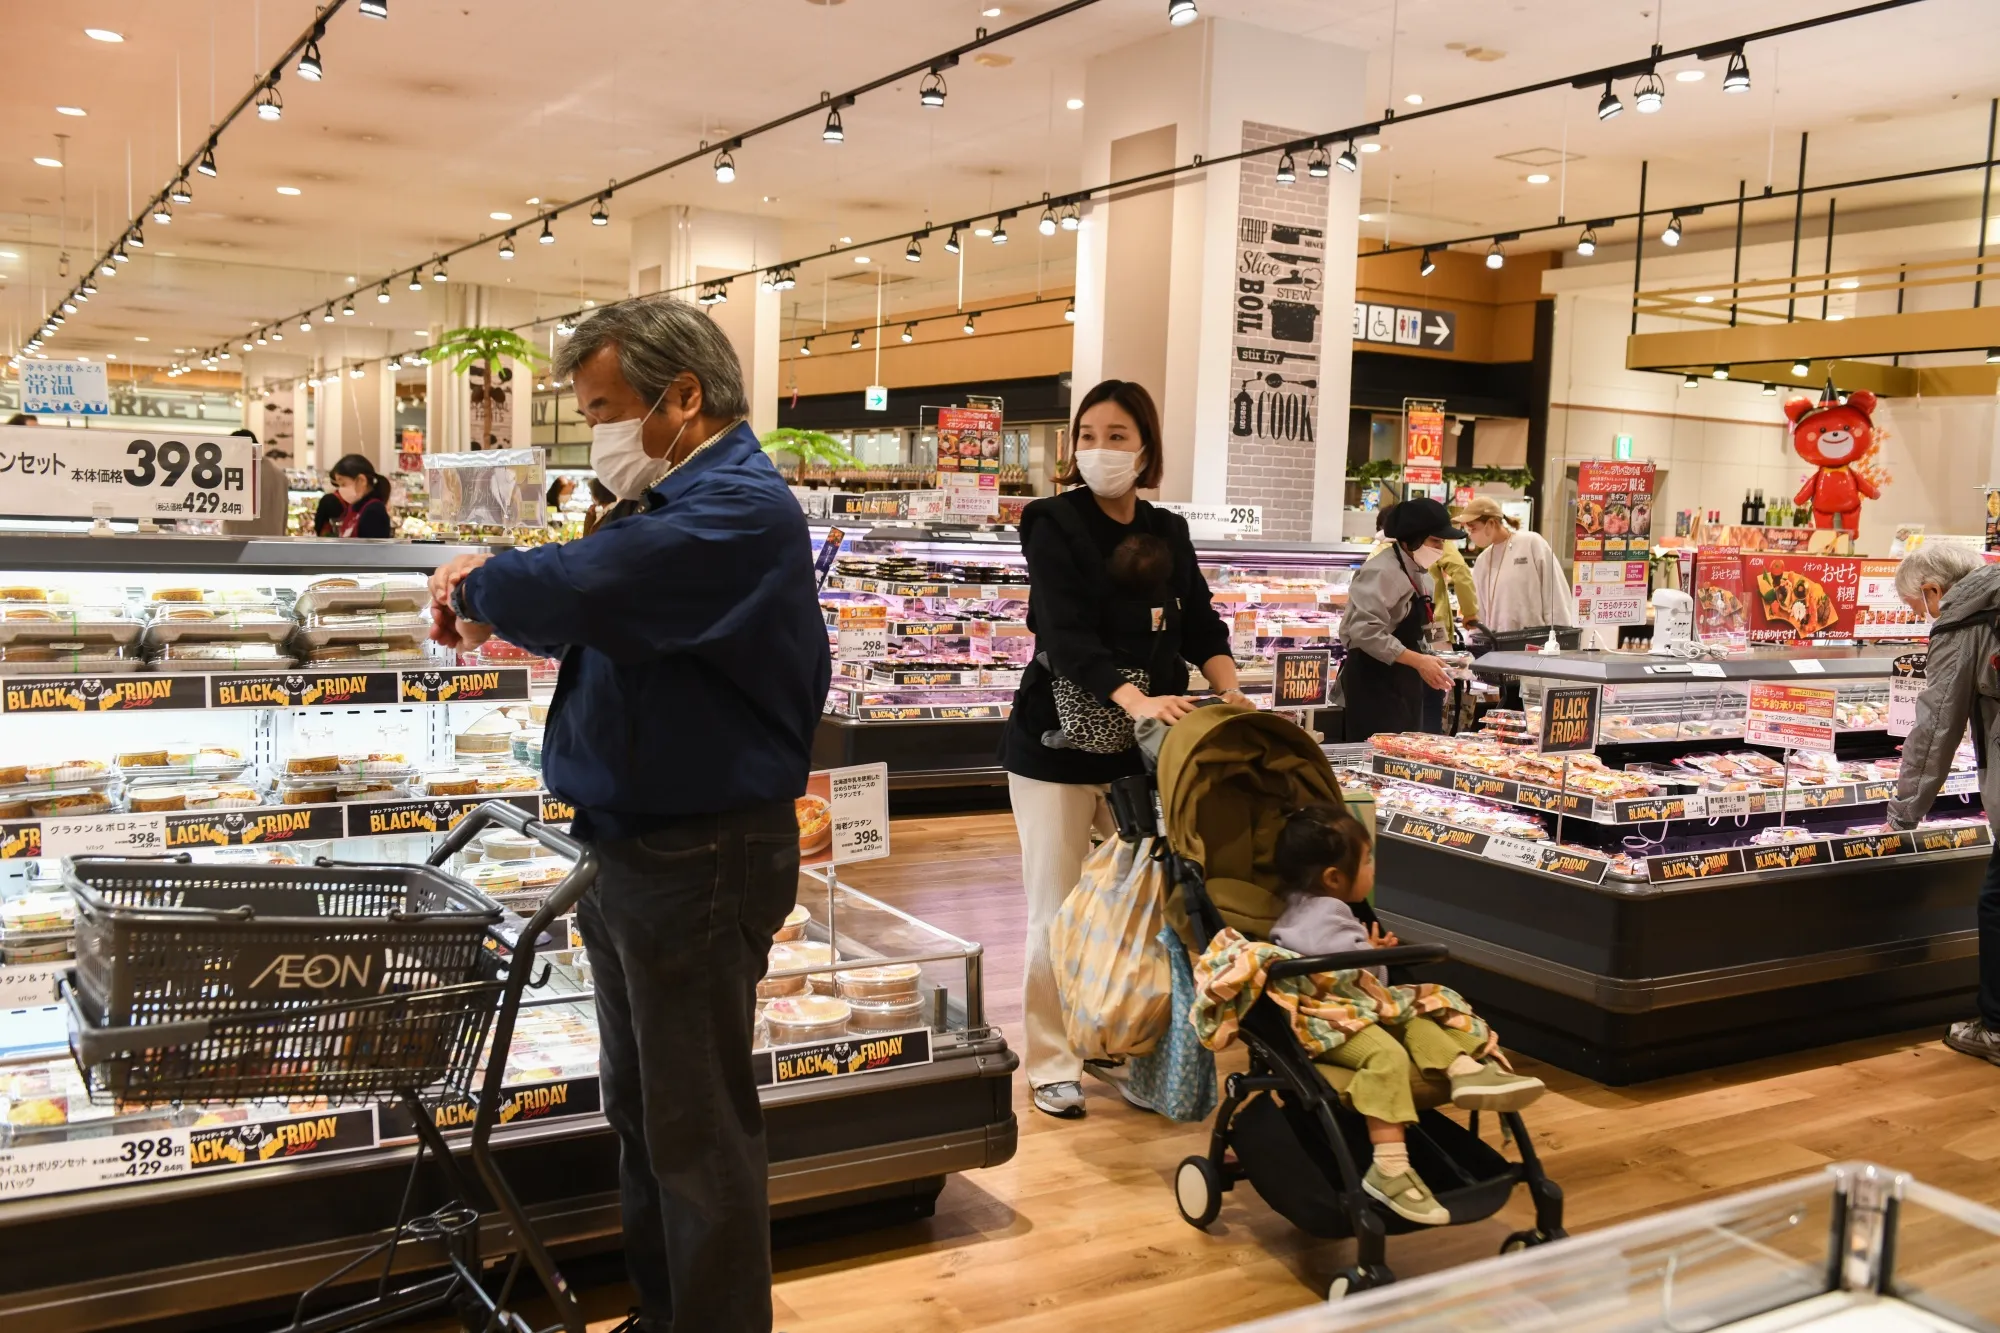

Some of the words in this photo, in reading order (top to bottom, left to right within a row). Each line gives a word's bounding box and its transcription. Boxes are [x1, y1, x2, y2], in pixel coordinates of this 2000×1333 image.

[1241, 217, 1268, 245] CHOP
[1239, 249, 1281, 277] Slice
[1276, 287, 1312, 301] STEW
[1236, 277, 1266, 334] BOIL
[1242, 348, 1262, 361] stir
[1263, 349, 1280, 364] fry
[25, 374, 75, 395] 常温
[1256, 390, 1315, 443] COOK
[1588, 482, 1628, 492] イオンショップ
[1629, 478, 1646, 492] 限定
[1803, 562, 1821, 571] イオンの
[1821, 562, 1859, 584] おせち
[1836, 586, 1856, 602] 料理
[1597, 601, 1638, 610] こちらのチラシを
[1597, 610, 1633, 618] お持ちください
[906, 625, 925, 635] BLACK
[936, 623, 954, 633] FRIDAY
[904, 675, 921, 684] BLACK
[935, 674, 952, 683] FRIDAY
[1284, 660, 1321, 680] BLACK
[219, 683, 273, 705] BLACK
[317, 676, 367, 694] FRIDAY
[452, 672, 499, 690] FRIDAY
[1283, 680, 1320, 700] FRIDAY
[8, 687, 67, 710] BLACK
[116, 680, 172, 700] FRIDAY
[1751, 697, 1806, 712] ご予約承り中
[870, 709, 890, 719] BLACK
[902, 708, 921, 718] FRIDAY
[941, 709, 959, 719] BLACK
[1384, 764, 1405, 775] BLACK
[1421, 768, 1442, 780] FRIDAY
[1481, 780, 1505, 793] FRIDAY
[1826, 787, 1845, 802] FRIDAY
[1865, 788, 1884, 800] BLACK
[1552, 794, 1579, 810] FRDAY
[258, 811, 311, 834] FRIDAY
[370, 810, 420, 833] BLACK
[1628, 807, 1651, 821] BLACK
[835, 819, 872, 831] 海老グラタン
[1402, 822, 1429, 837] BLACK
[1445, 830, 1475, 844] FRIDAY
[1844, 843, 1866, 858] BLACK
[1880, 836, 1902, 850] FRIDAY
[1922, 835, 1944, 850] BLACK
[1958, 828, 1977, 842] FRIDAY
[1559, 857, 1589, 872] FRIDAY
[1755, 852, 1779, 868] BLACK
[1795, 844, 1817, 860] FRIDAY
[1663, 862, 1687, 879] BLACK
[1704, 853, 1729, 869] FRIDAY
[778, 1054, 825, 1081] BLACK
[861, 1036, 903, 1061] FRIDAY
[515, 1083, 568, 1111] FRIDAY
[277, 1117, 337, 1146] FRIDAY
